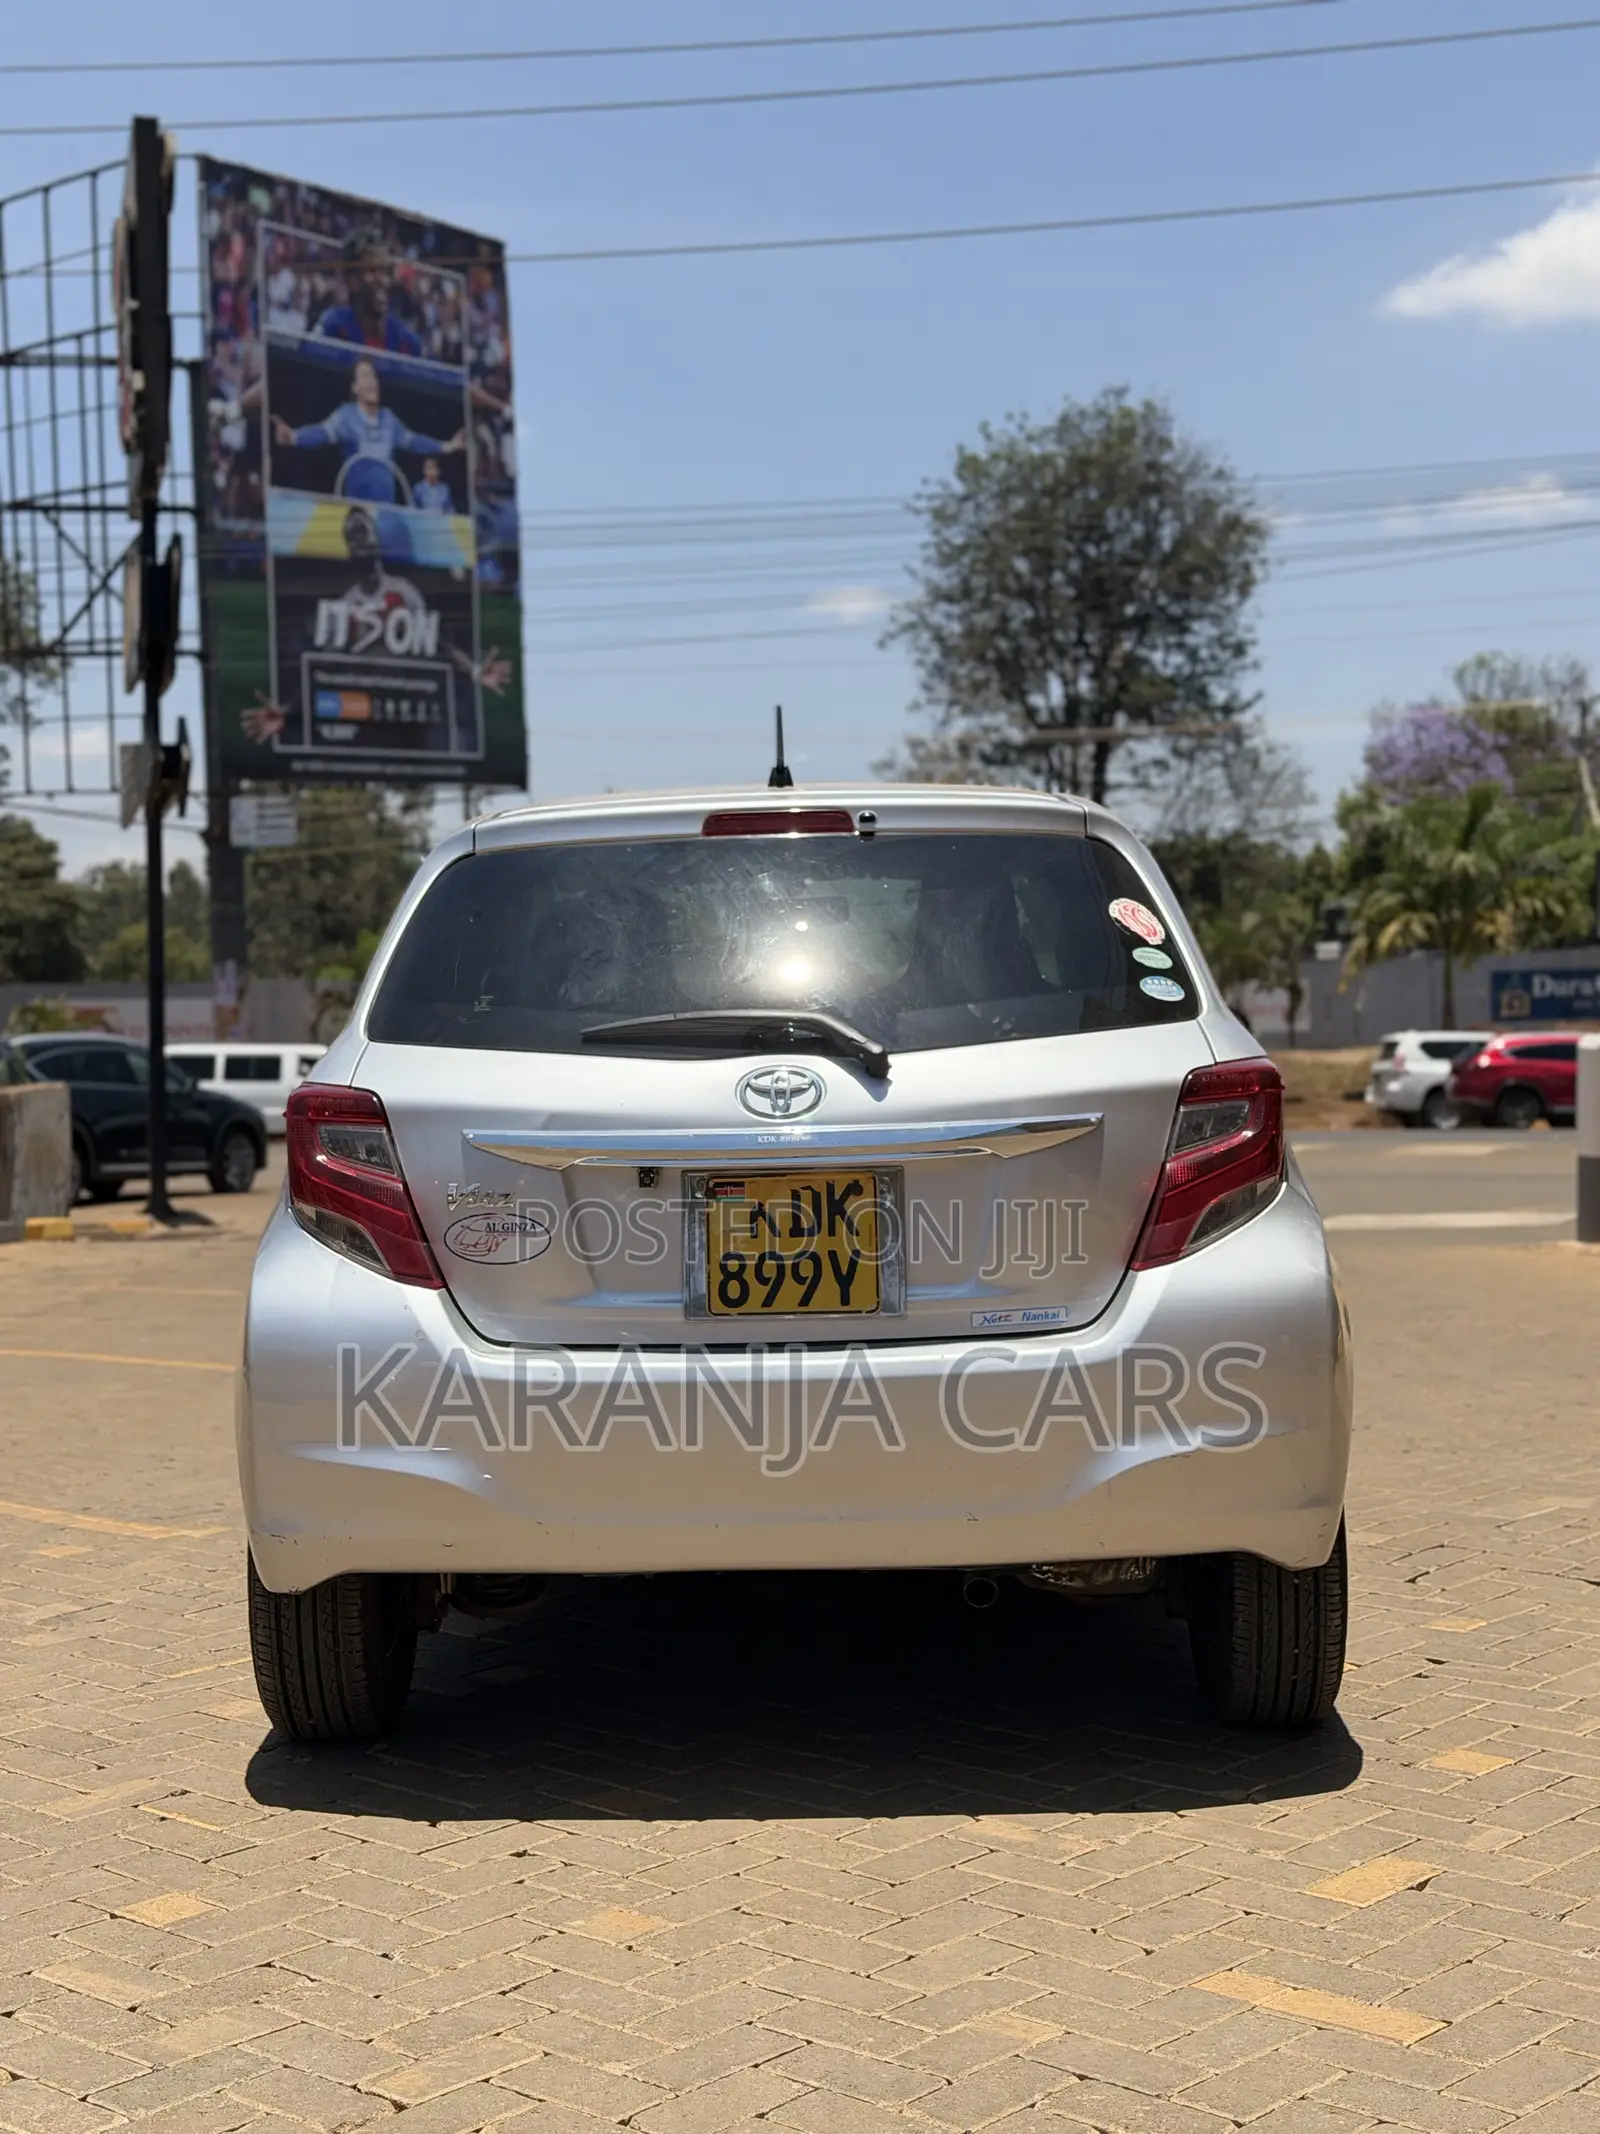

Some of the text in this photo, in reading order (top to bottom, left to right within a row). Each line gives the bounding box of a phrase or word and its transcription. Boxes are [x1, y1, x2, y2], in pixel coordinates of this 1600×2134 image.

[750, 1180, 863, 1239] KDK
[718, 1250, 861, 1308] 899Y
[1022, 1310, 1060, 1321] Nankai
